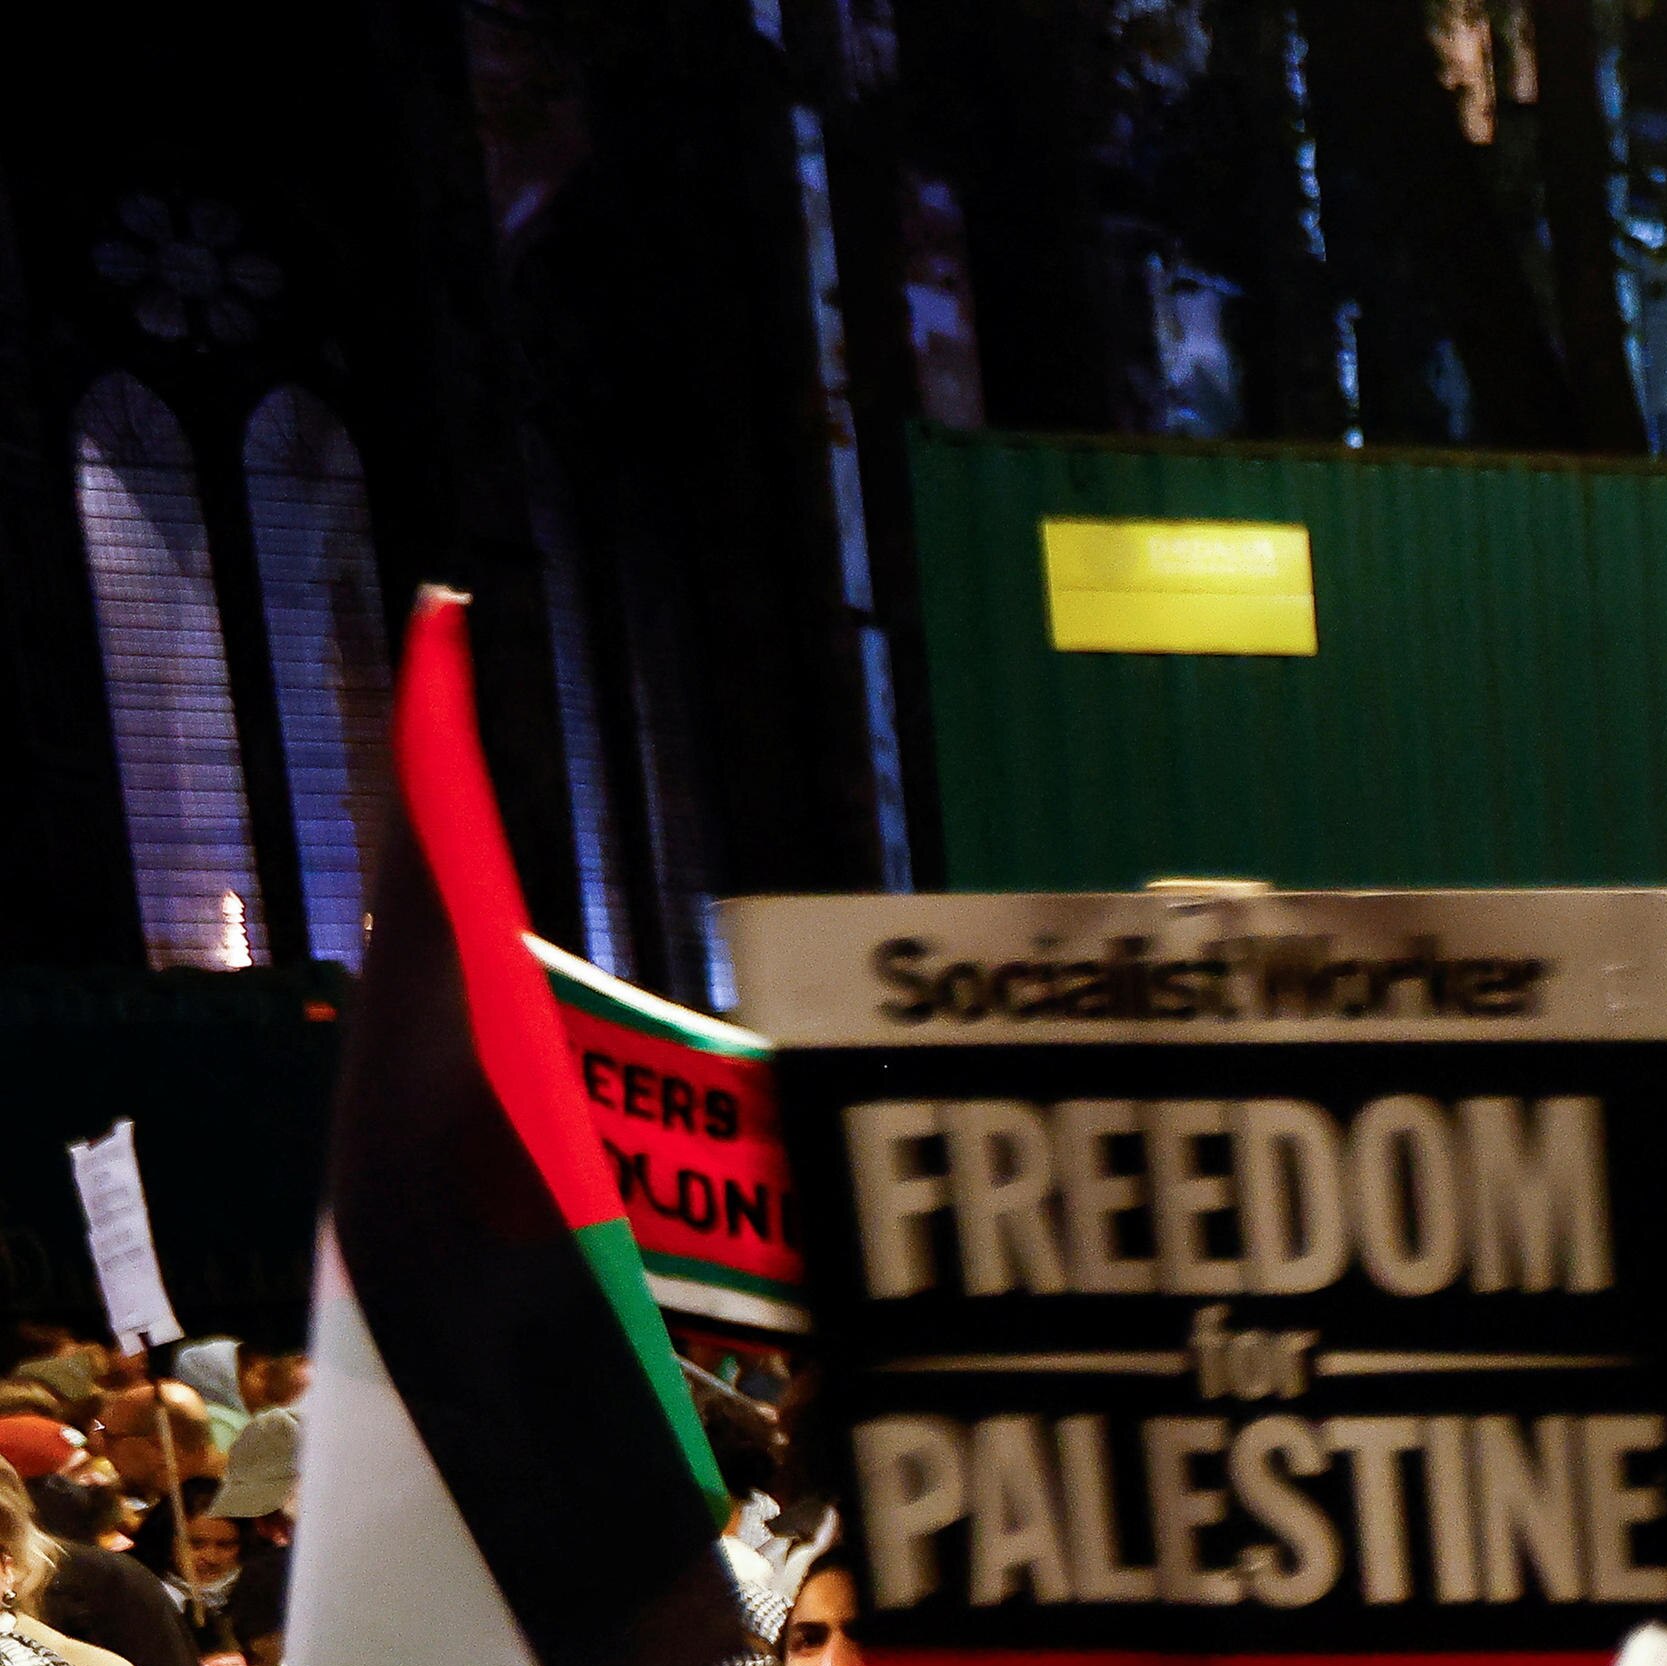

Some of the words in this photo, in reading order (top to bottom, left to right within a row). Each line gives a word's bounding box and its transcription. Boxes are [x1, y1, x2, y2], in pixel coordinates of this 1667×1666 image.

[871, 935, 1228, 1022] Socialist
[842, 1092, 1616, 1300] FREEDOM
[1190, 1306, 1320, 1402] for
